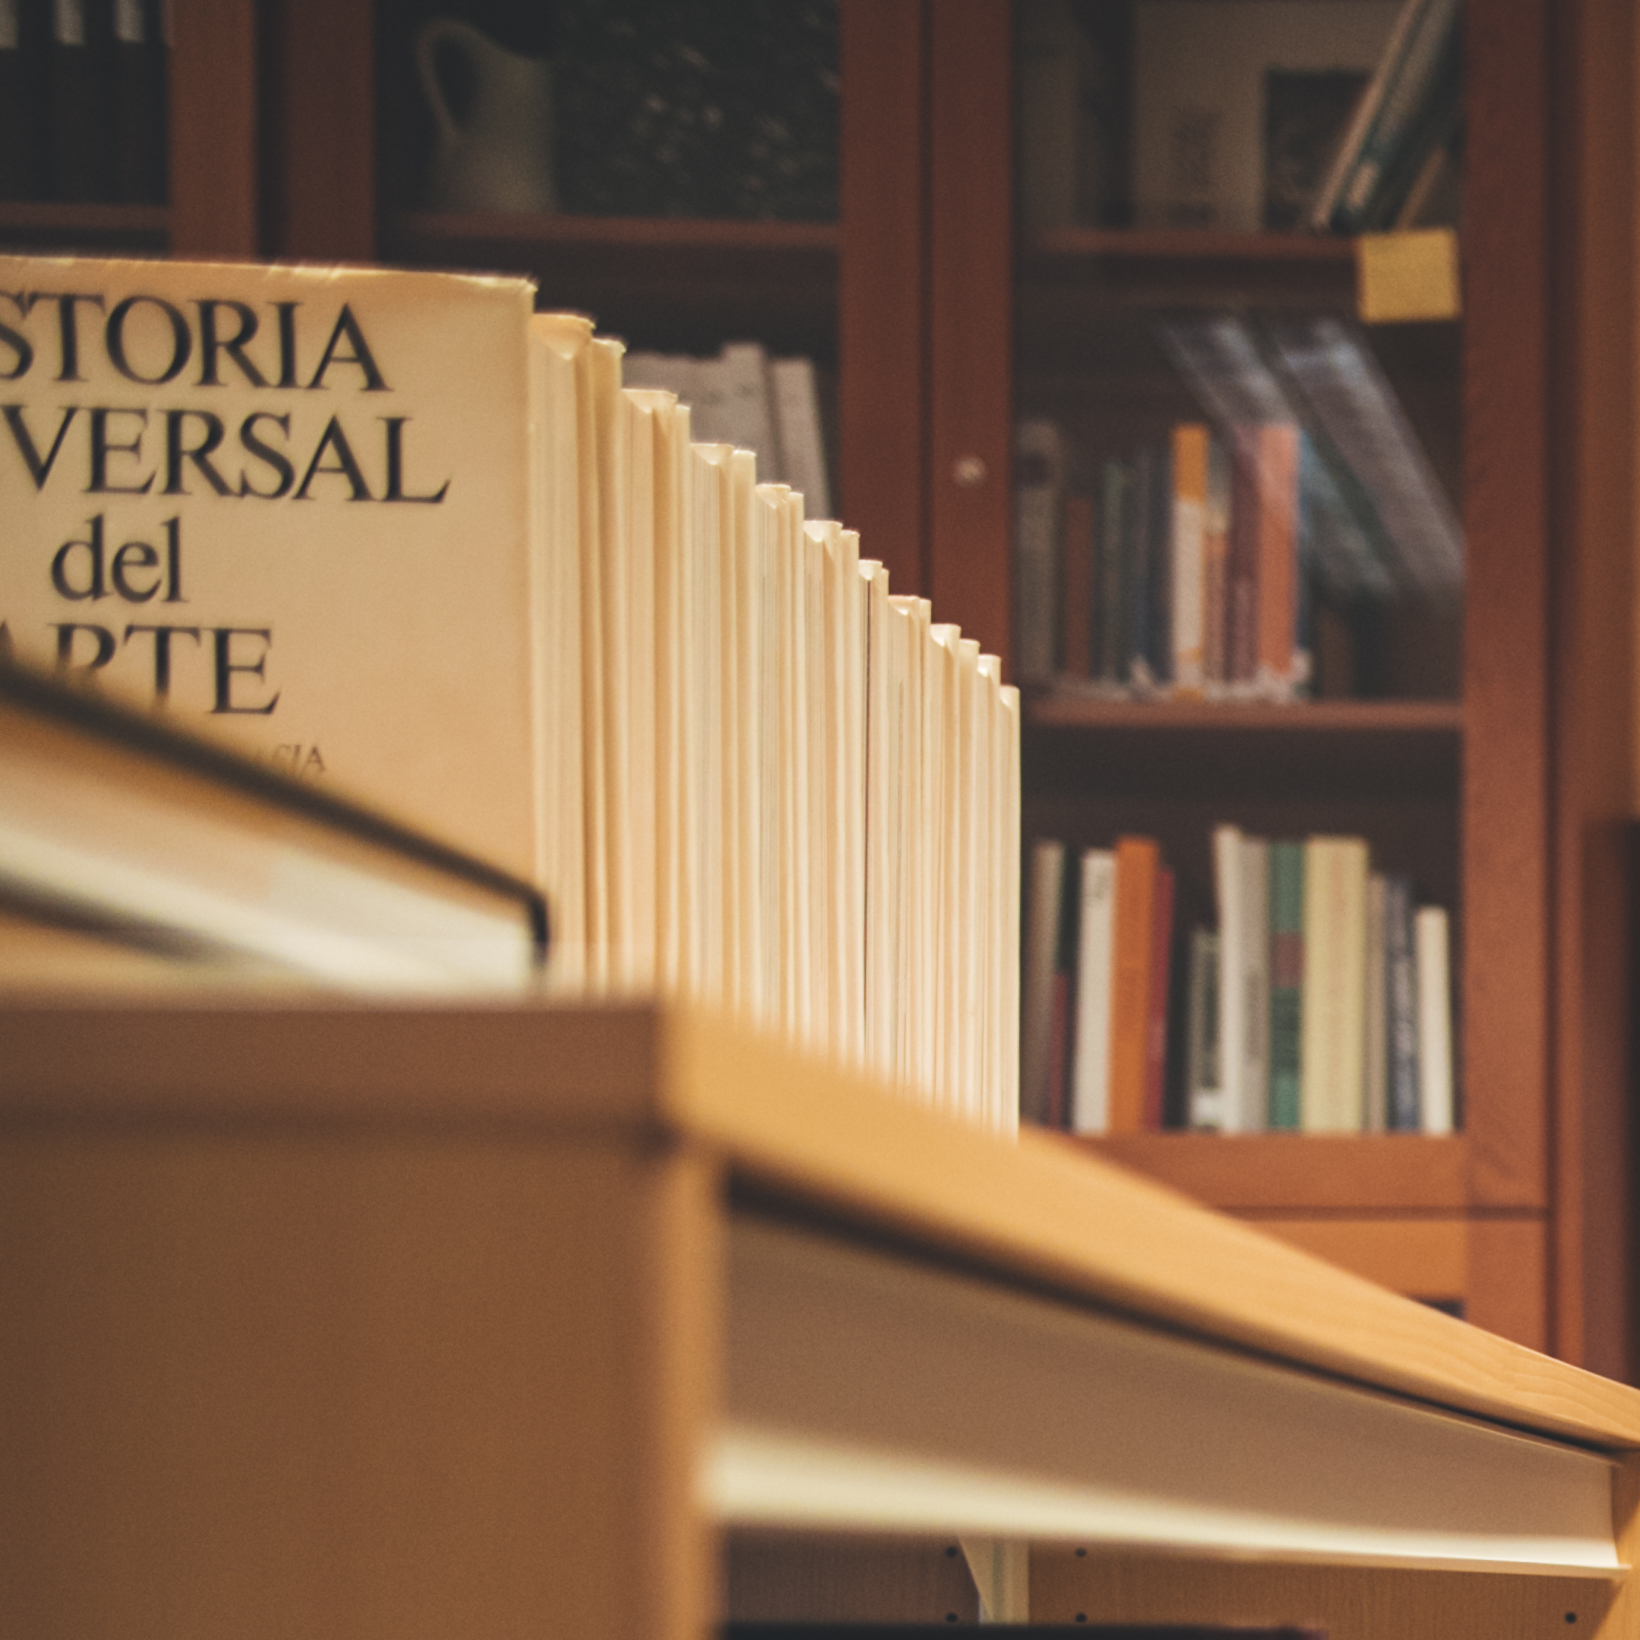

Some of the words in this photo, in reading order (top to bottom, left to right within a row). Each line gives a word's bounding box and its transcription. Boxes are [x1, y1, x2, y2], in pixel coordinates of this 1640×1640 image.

[0, 403, 452, 503] VERSAL
[50, 512, 190, 603] del
[0, 620, 282, 715] RTE
